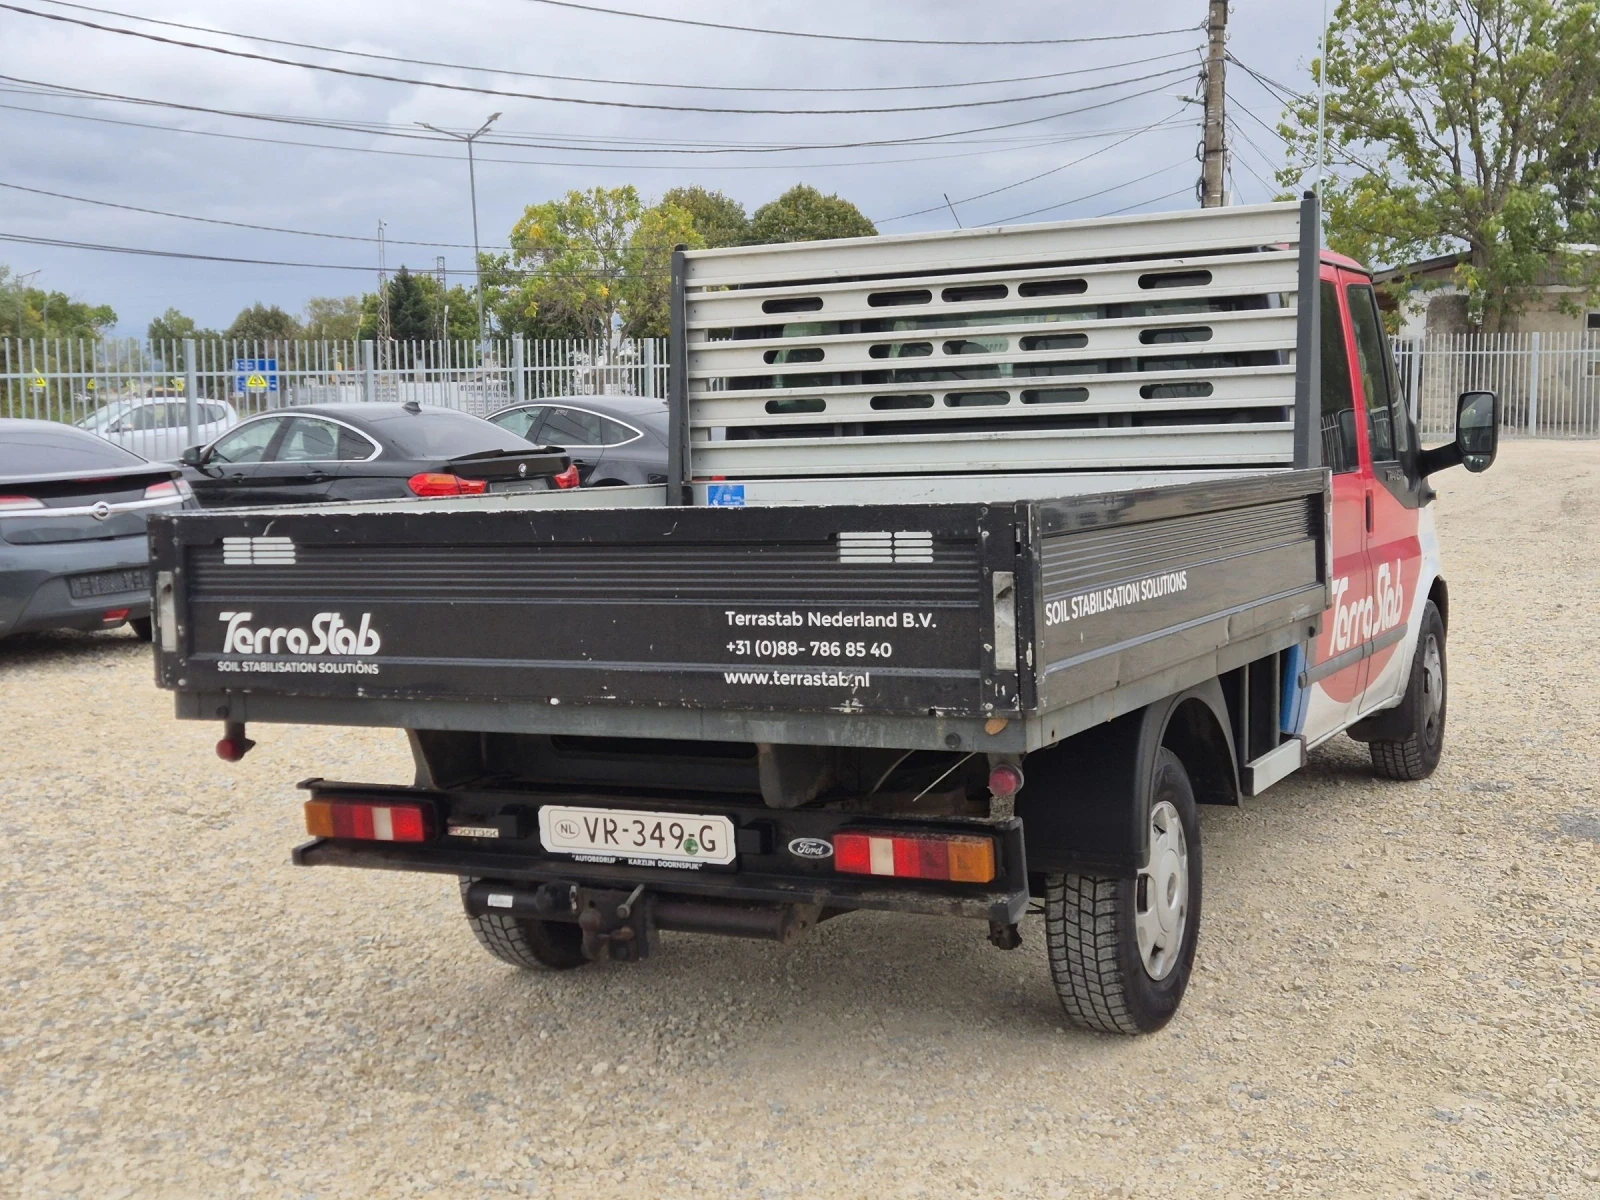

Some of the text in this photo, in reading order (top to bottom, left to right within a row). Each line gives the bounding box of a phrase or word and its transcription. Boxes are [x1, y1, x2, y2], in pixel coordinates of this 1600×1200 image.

[1045, 570, 1188, 627] SOIL STABILISATION SOLUTIONS
[725, 611, 937, 628] Terrastab Nederland B.V.
[218, 611, 381, 655] TerraStab
[726, 640, 751, 655] +31
[809, 641, 841, 657] 786
[845, 642, 866, 657] 85
[870, 642, 892, 658] 40
[217, 660, 240, 672] SOIL
[242, 661, 317, 673] STABILISATION
[724, 670, 870, 688] www.terrastab.nl
[560, 824, 576, 835] NL
[583, 816, 716, 852] VR-349-G
[797, 841, 824, 855] Ford
